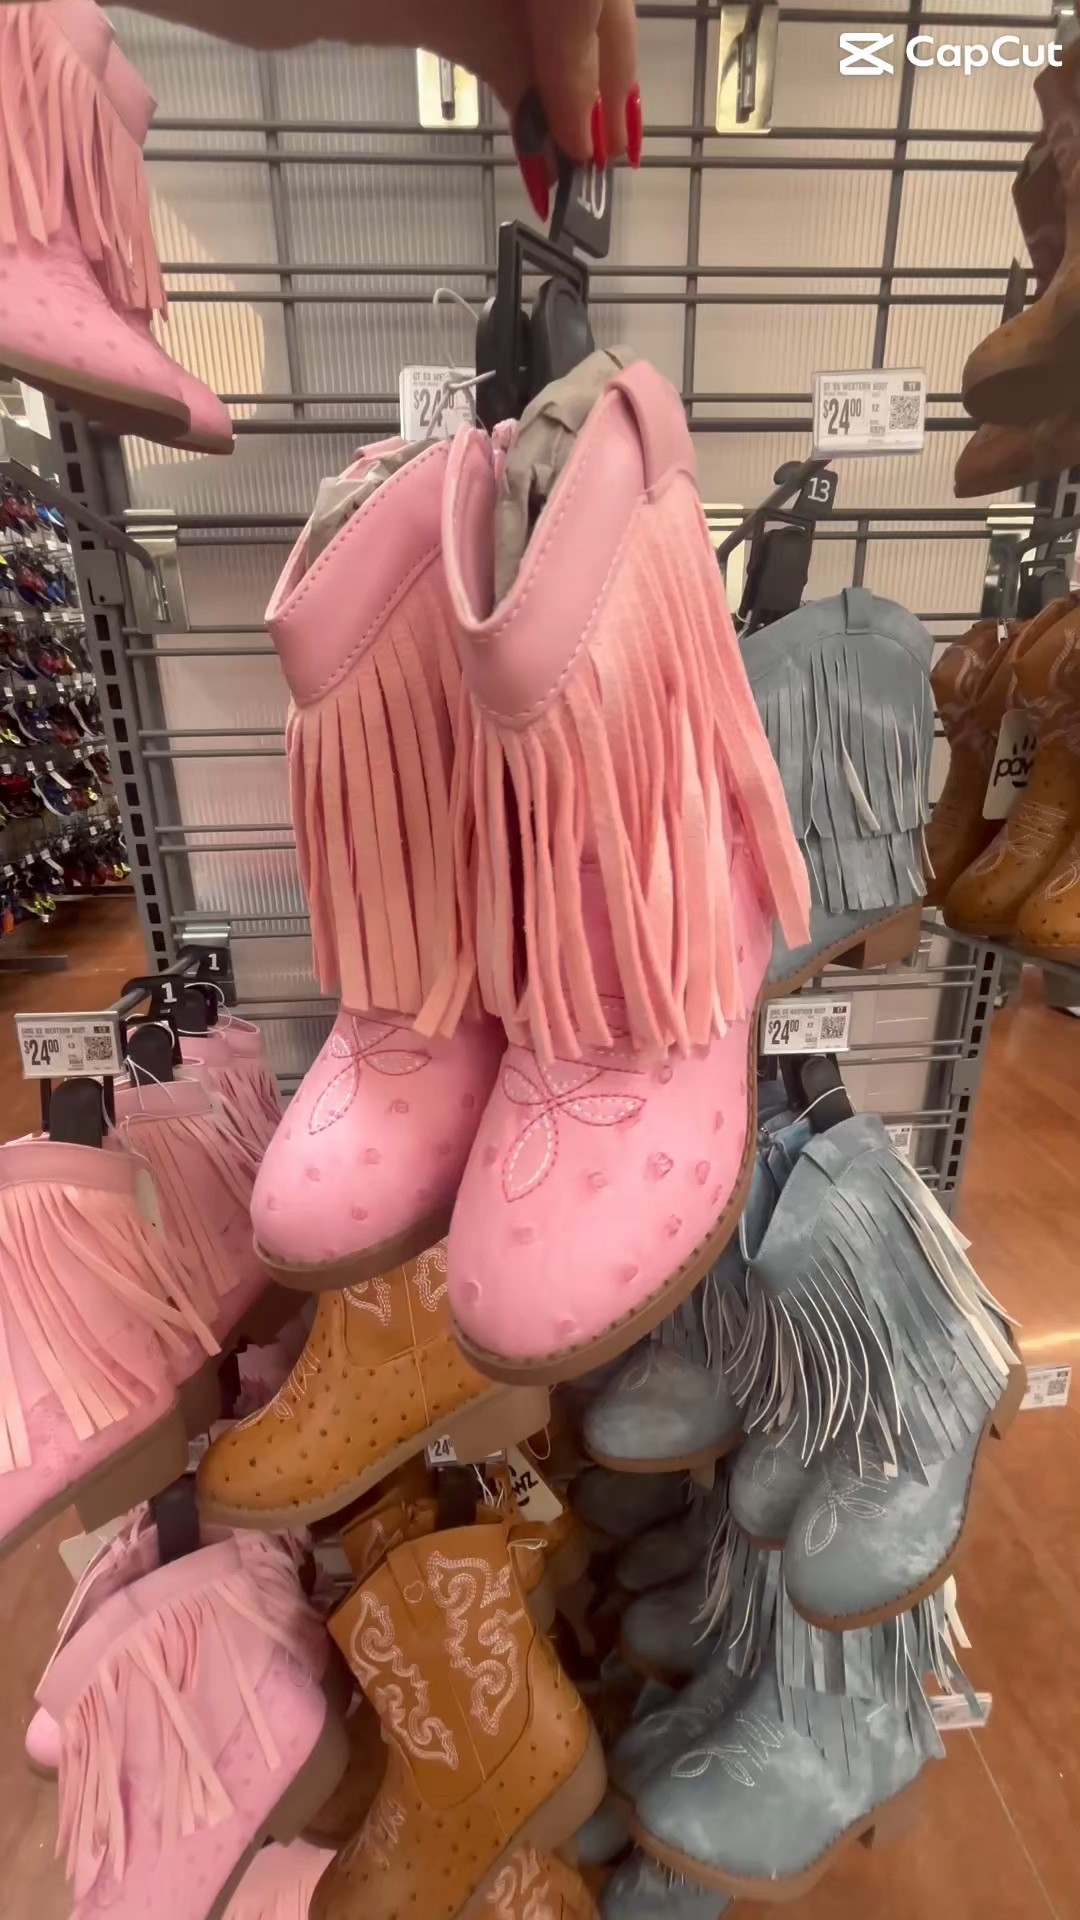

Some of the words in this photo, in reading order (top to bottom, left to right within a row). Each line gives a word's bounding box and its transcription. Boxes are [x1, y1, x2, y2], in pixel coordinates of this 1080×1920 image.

[807, 476, 831, 502] 13
[208, 953, 220, 971] 1
[161, 982, 177, 1003] 1
